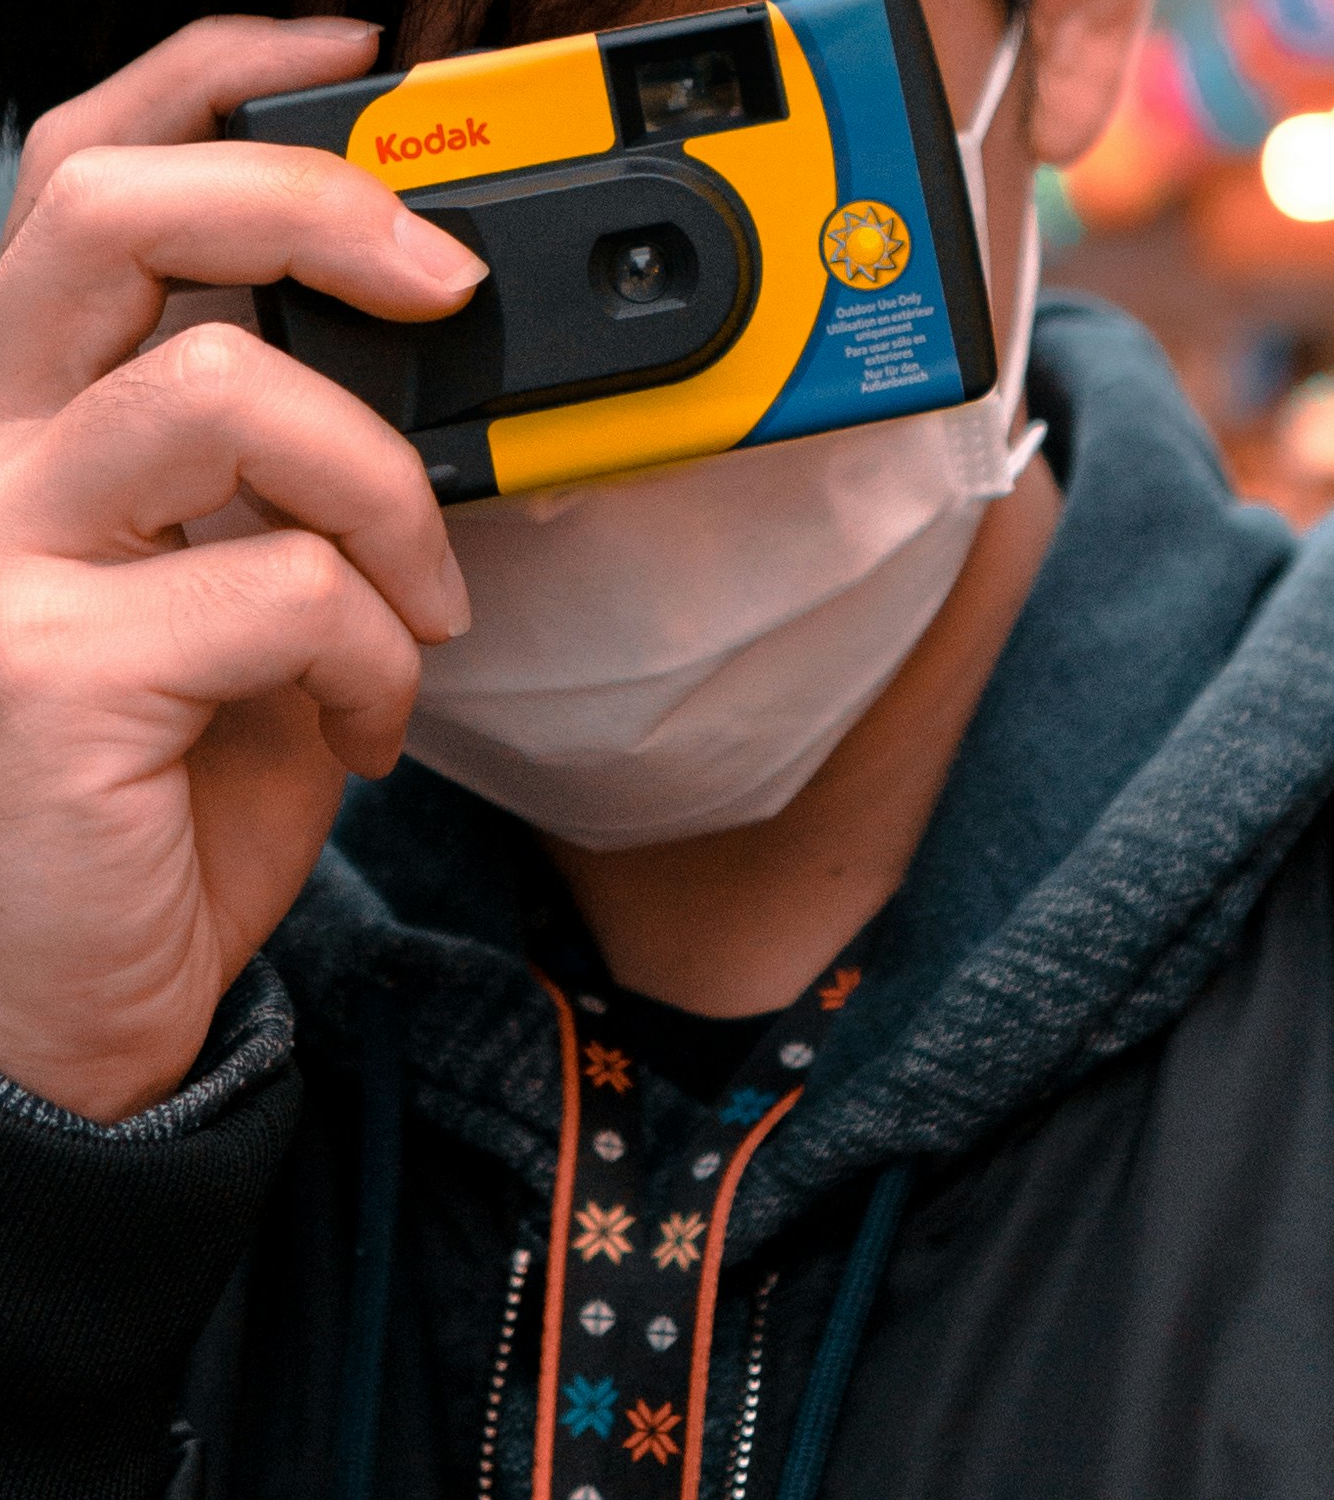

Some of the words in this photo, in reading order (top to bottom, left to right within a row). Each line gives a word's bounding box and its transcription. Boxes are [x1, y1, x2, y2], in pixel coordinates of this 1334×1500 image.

[375, 117, 491, 165] Kodak
[835, 303, 876, 319] Outdoor
[877, 298, 898, 311] Use
[898, 292, 922, 307] Only
[826, 318, 877, 335] Utilisation
[877, 315, 890, 326] en
[855, 321, 913, 342] uniquement
[844, 345, 868, 358] Para
[869, 342, 890, 354] usar
[864, 369, 884, 380] Nur
